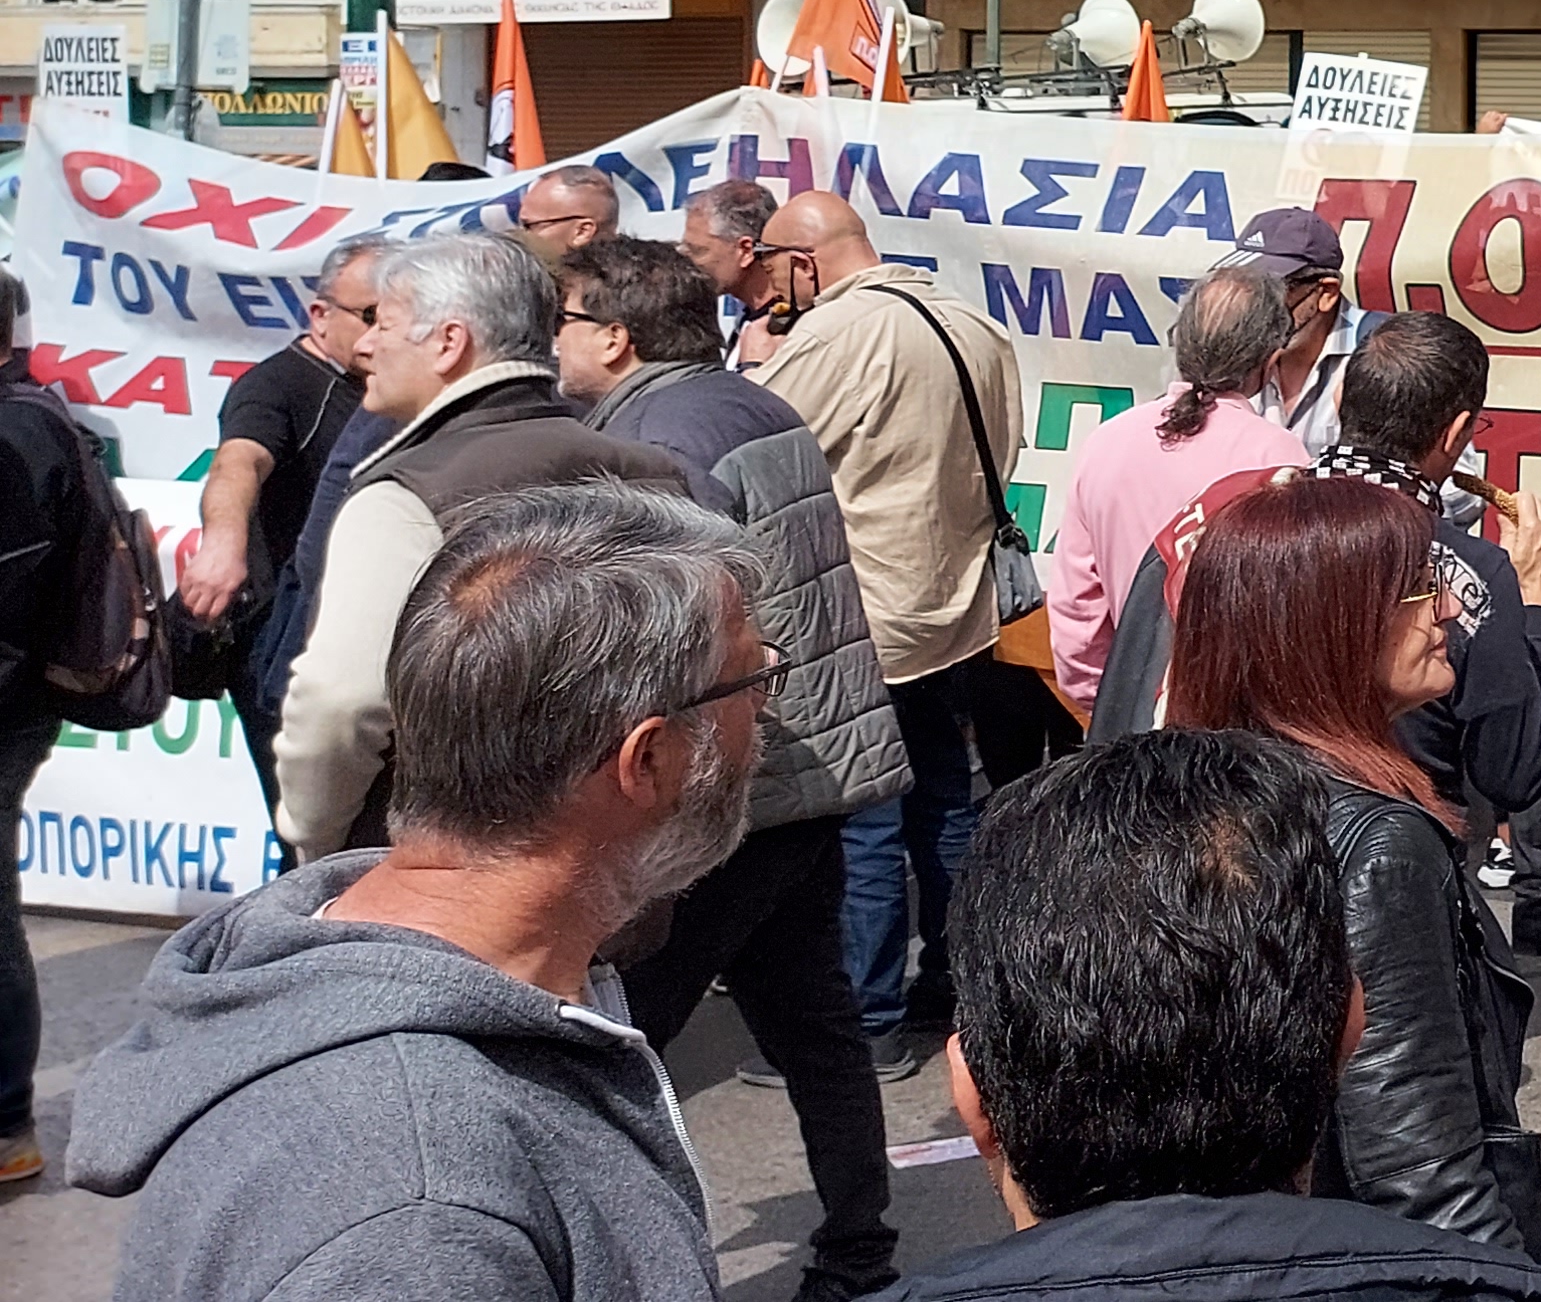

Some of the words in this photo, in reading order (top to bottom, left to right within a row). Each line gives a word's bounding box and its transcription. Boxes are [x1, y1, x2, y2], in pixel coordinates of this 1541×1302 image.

[43, 36, 121, 63] ΔΟΥΛΕΙΕΣ
[44, 70, 122, 97] ΑΥΞΗΣΕΙΣ
[1306, 64, 1418, 100] ΔΟΥΛΕΙΕΣ
[1298, 95, 1410, 130] ΑΥΞΗΣΕΙΣ
[62, 150, 353, 251] ΟΧΙ
[62, 240, 198, 322] ΤΟΥ
